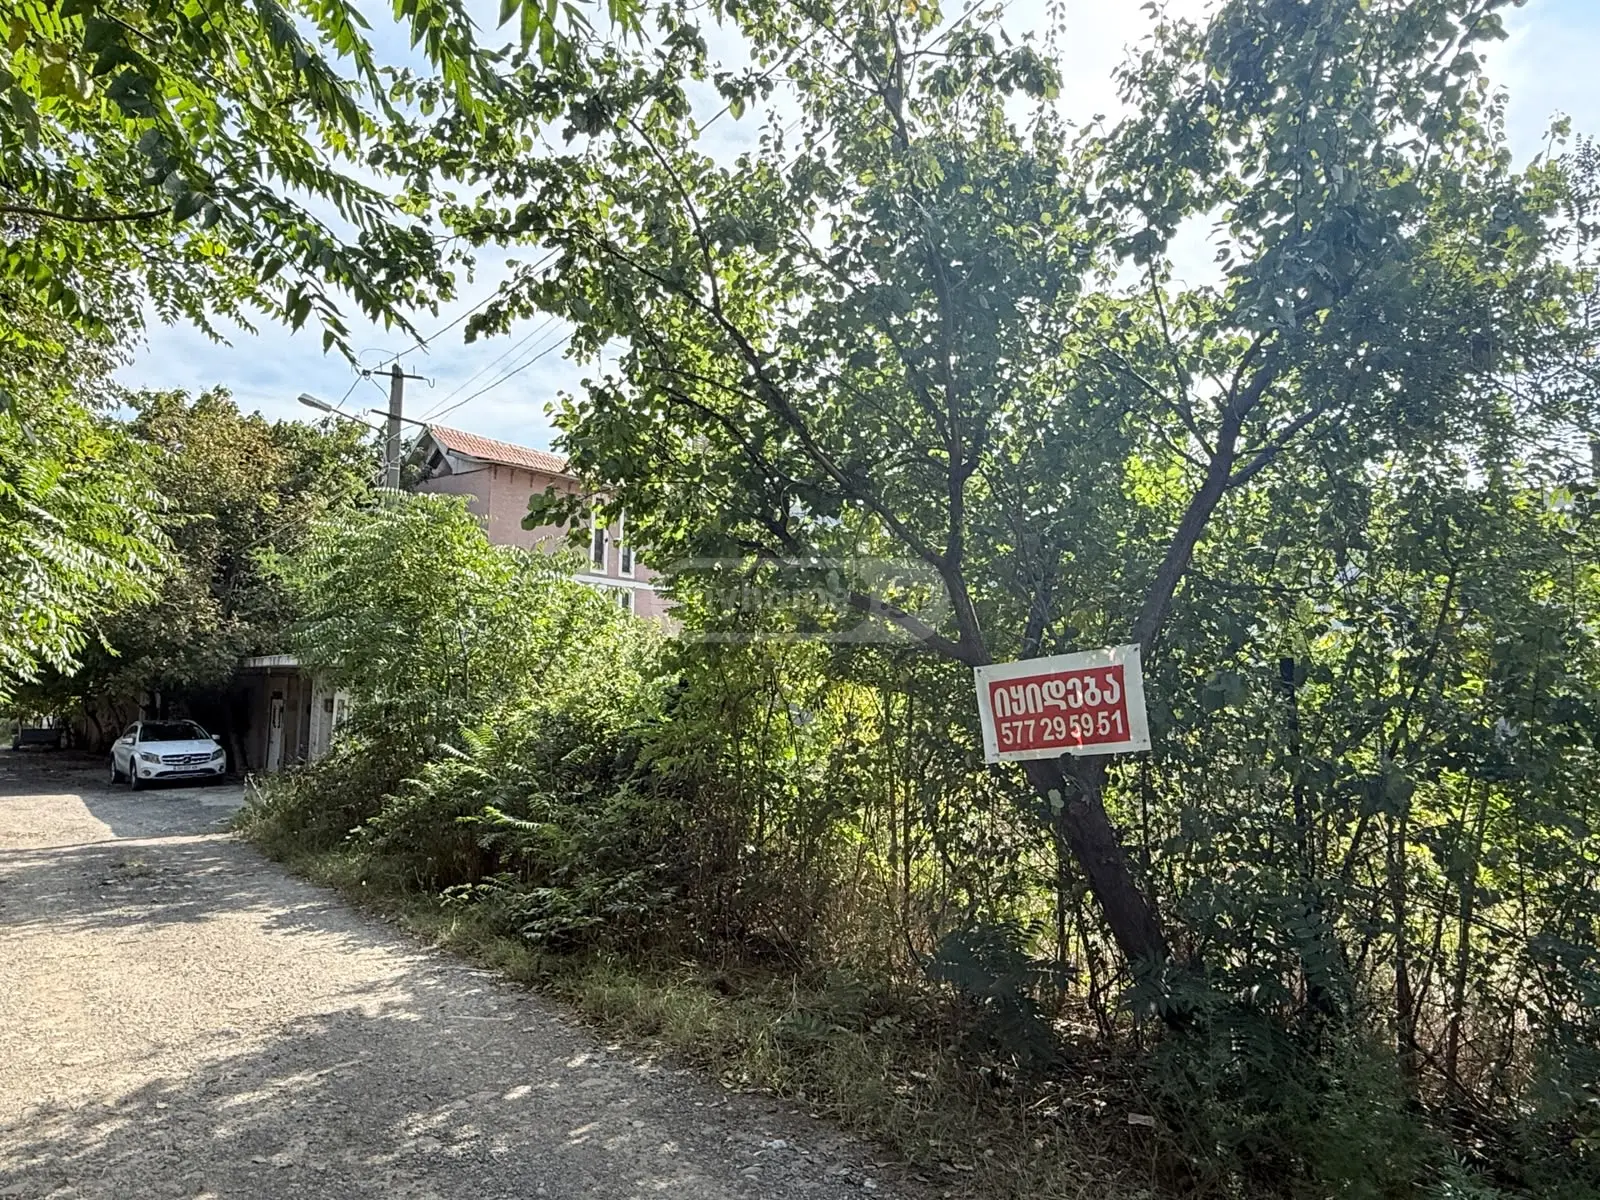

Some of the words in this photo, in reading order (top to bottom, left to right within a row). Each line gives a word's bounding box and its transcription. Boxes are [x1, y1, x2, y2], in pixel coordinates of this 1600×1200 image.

[994, 673, 1121, 718] იყიდება
[1001, 719, 1036, 745] 577
[1040, 716, 1066, 741] 29
[1097, 709, 1123, 736] 51
